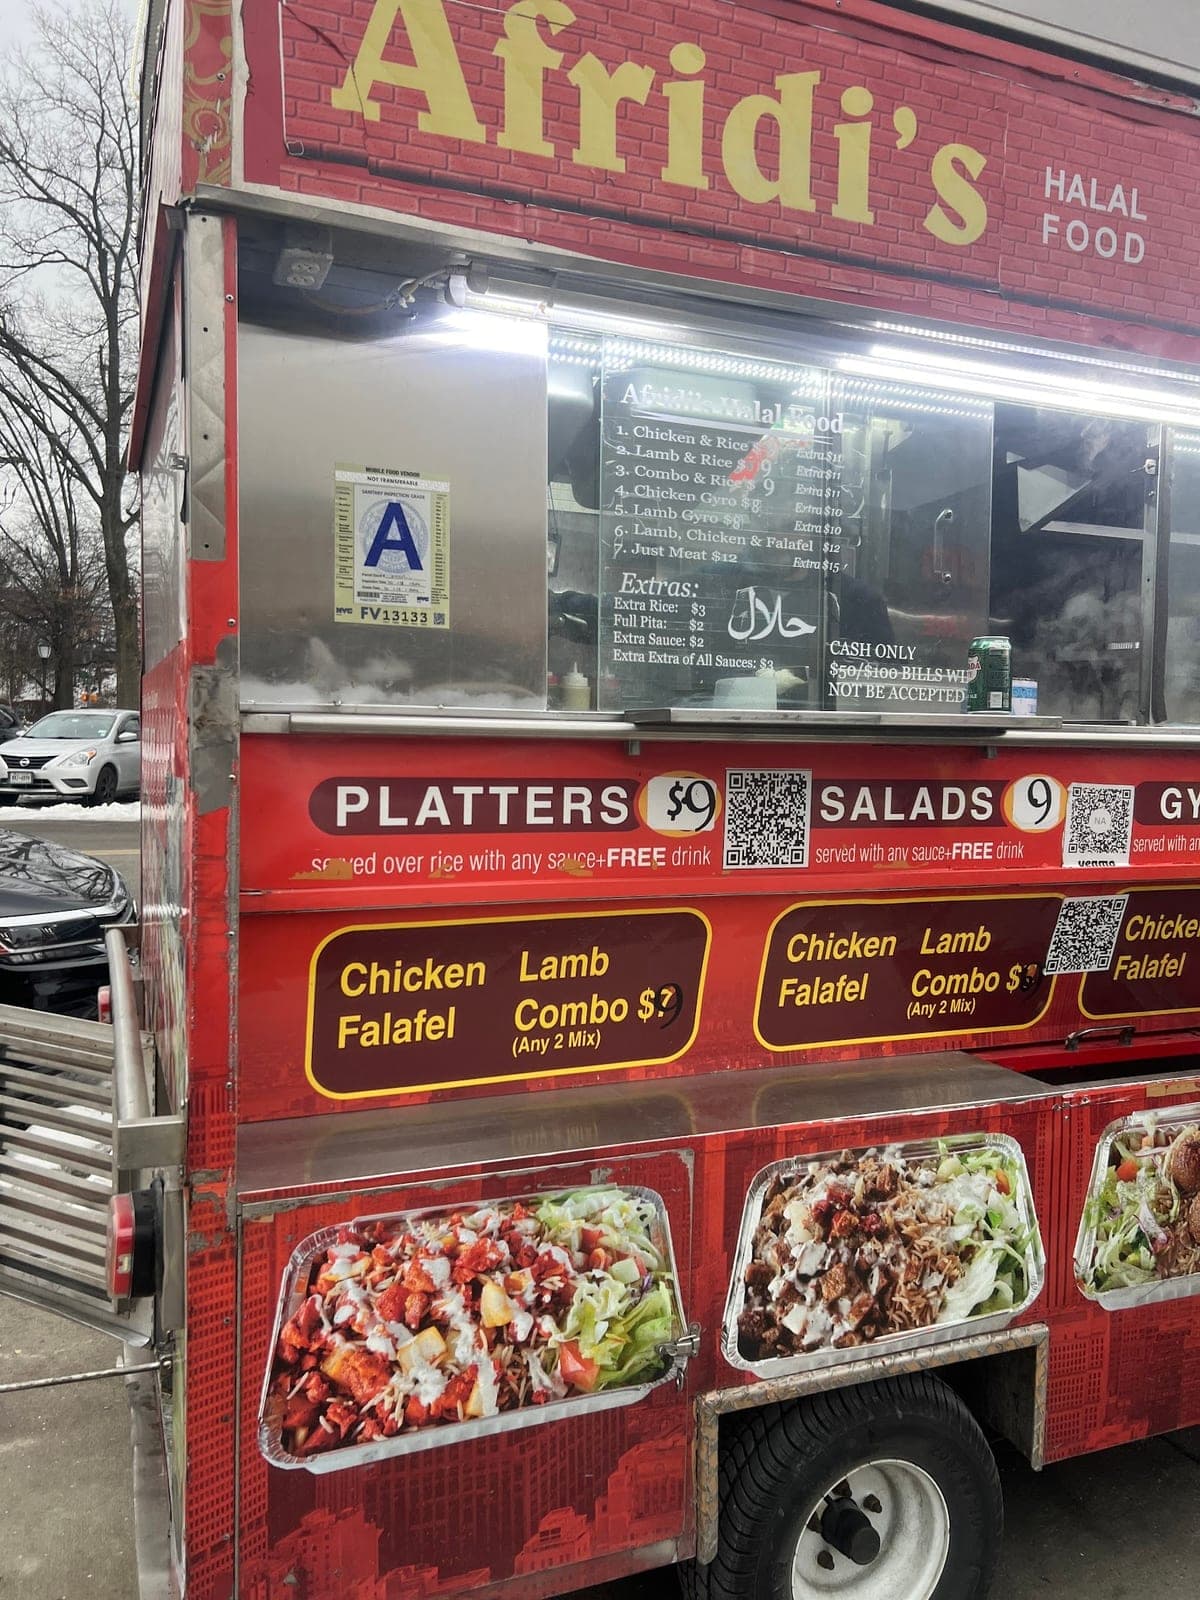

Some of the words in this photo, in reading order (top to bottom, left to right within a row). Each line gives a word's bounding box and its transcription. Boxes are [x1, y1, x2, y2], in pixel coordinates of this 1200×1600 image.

[330, 0, 989, 247] Afridi's
[1043, 166, 1148, 222] HALAL
[1042, 214, 1146, 266] FOOD
[616, 425, 628, 436] 1.
[633, 425, 696, 445] Chicken
[700, 435, 713, 447] &
[716, 436, 748, 452] Rice
[616, 445, 630, 456] 2.
[635, 444, 679, 463] Lamb
[683, 451, 697, 463] &
[700, 452, 733, 468] Rice
[796, 448, 824, 460] Extra
[615, 465, 629, 476] 3.
[634, 465, 689, 484] Combo
[693, 473, 706, 485] &
[710, 474, 744, 488] Rice
[796, 465, 823, 479] Extra
[825, 468, 841, 480] $11
[614, 485, 629, 496] 4.
[633, 484, 696, 502] Chicken
[701, 491, 737, 508] Gyro
[794, 482, 822, 497] Extra
[824, 487, 841, 499] $11
[614, 504, 628, 516] 5.
[633, 504, 677, 520] Lamb
[681, 509, 719, 525] Gyro
[794, 502, 822, 515] Extra
[823, 505, 843, 518] $10
[364, 502, 424, 571] A
[614, 525, 628, 537] 6.
[633, 524, 682, 542] Lamb,
[686, 529, 746, 546] Chicken
[750, 535, 764, 548] &
[766, 536, 814, 552] Falafel
[822, 541, 841, 554] $12
[793, 520, 822, 533] Extra
[823, 522, 842, 536] $10
[612, 543, 627, 559] 7.
[631, 543, 663, 558] Just
[668, 546, 708, 561] Meat
[711, 550, 738, 563] $12
[793, 556, 821, 569] Extra
[821, 557, 841, 574] $15
[618, 572, 700, 598] Extras:
[614, 597, 646, 612] Extra
[649, 598, 679, 613] Rice:
[691, 603, 706, 617] $3
[727, 585, 817, 640] حلال
[614, 614, 640, 628] Full
[642, 615, 667, 629] Pita:
[689, 619, 704, 632] $2
[613, 630, 645, 645] Extra
[649, 633, 686, 648] Sauce:
[689, 635, 704, 648] $2
[829, 640, 871, 657] CASH
[875, 643, 917, 661] ONLY
[613, 649, 645, 663] Extra
[648, 651, 679, 665] Extra
[682, 653, 695, 666] of
[696, 654, 712, 666] All
[715, 655, 757, 669] Sauces:
[829, 660, 898, 680] $50/$100
[901, 665, 943, 682] BILLS
[946, 669, 968, 684] WI
[828, 682, 862, 698] NOT
[865, 685, 886, 699] BE
[890, 686, 966, 703] ACCEPTED
[336, 785, 630, 827] PLATTERS
[666, 776, 717, 833] $9
[819, 785, 994, 822] SALADS
[1025, 778, 1052, 824] 9
[1094, 817, 1107, 825] NA
[815, 843, 856, 864] served
[859, 843, 884, 862] with
[996, 841, 1024, 859] drink
[1132, 834, 1166, 853] served
[1167, 834, 1187, 852] with
[311, 852, 377, 875] seed
[383, 855, 424, 874] over
[430, 850, 464, 873] rice
[469, 849, 506, 872] with
[511, 852, 543, 874] any
[671, 846, 711, 867] drink
[786, 930, 897, 964] Chicken
[919, 925, 992, 955] Lamb
[340, 957, 487, 998] Chicken
[519, 946, 610, 983] Lamb
[1113, 951, 1187, 981] Falafel
[778, 972, 868, 1008] Falafel
[911, 963, 1000, 998] Combo
[513, 990, 629, 1033] Combo
[906, 1001, 936, 1019] (Any
[938, 1000, 948, 1015] 2
[949, 997, 976, 1016] Mix)
[337, 1006, 456, 1049] Falafel
[511, 1033, 550, 1059] (Any
[554, 1034, 565, 1050] 2
[567, 1029, 602, 1051] Mix)
